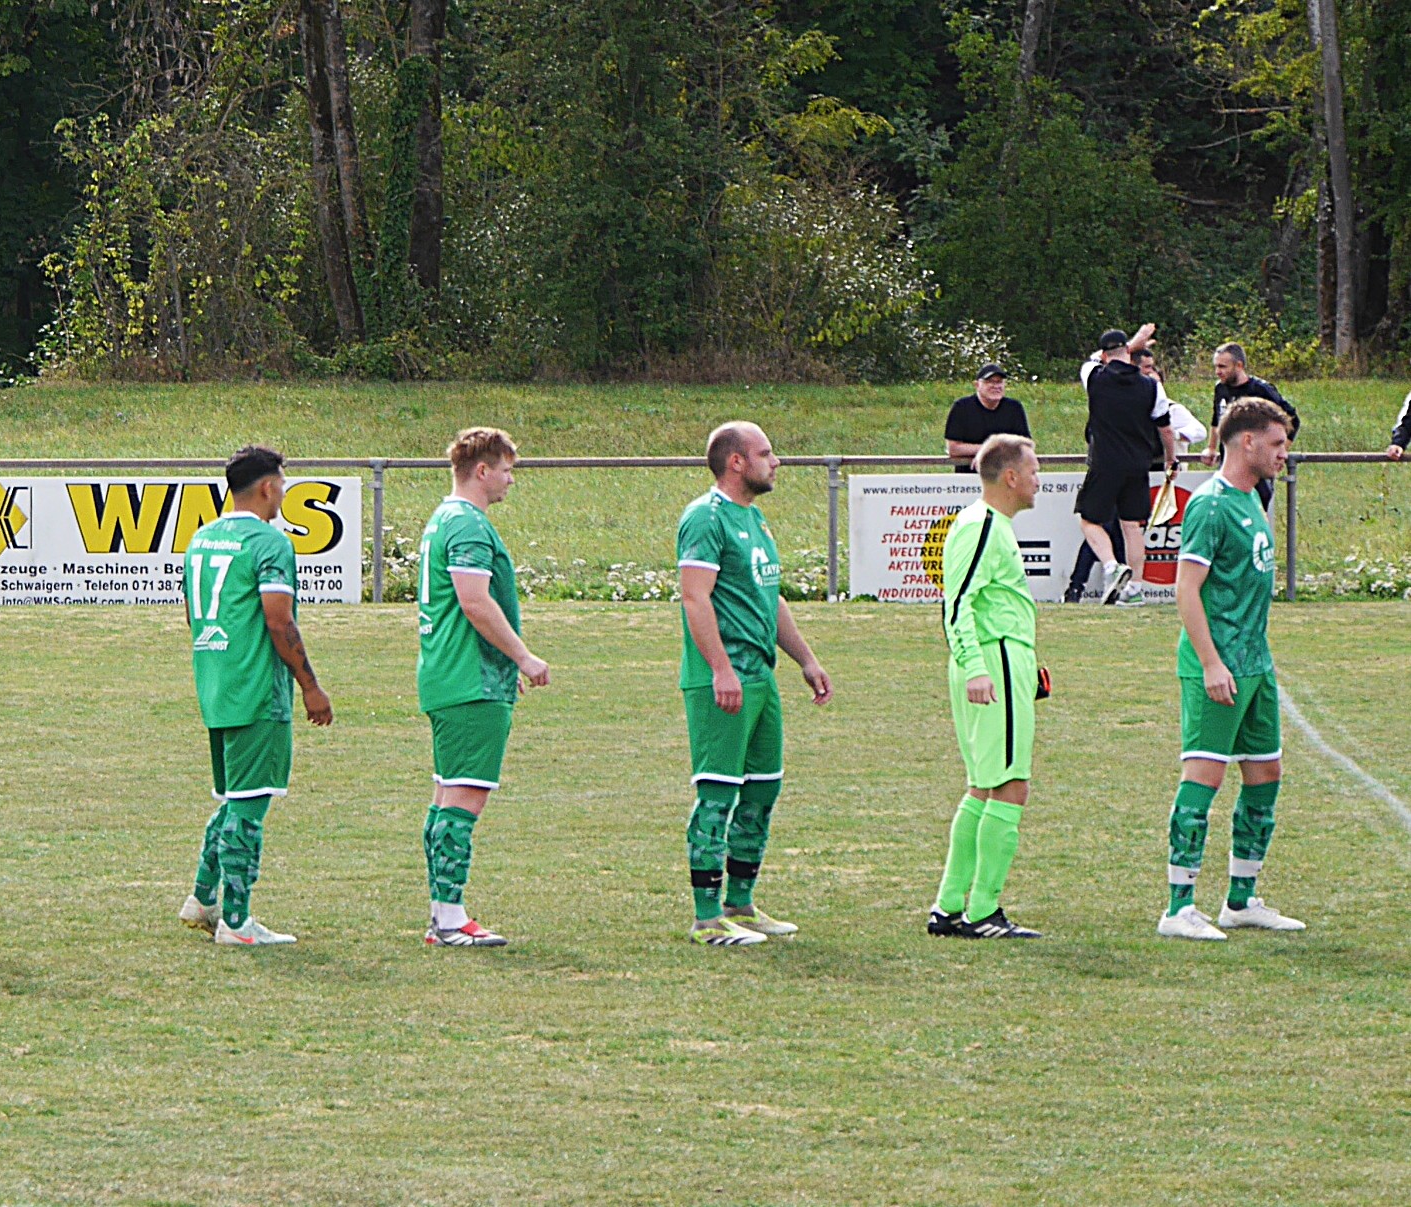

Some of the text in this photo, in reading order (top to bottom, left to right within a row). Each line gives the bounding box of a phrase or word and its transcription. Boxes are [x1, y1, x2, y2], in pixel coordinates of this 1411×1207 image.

[862, 485, 982, 494] www.reisebuero-straess
[904, 520, 953, 530] LASTMIN
[890, 547, 944, 557] WELTREIS
[63, 563, 149, 575] Maschinen
[164, 563, 184, 575] Be
[296, 565, 343, 577] ungen
[888, 560, 944, 571] AKTIVURL
[0, 580, 73, 593] Schwaigern
[84, 580, 129, 591] Telefon
[157, 580, 183, 592] 38/7
[191, 553, 234, 620] 17
[877, 588, 944, 598] INDIVIDUAL
